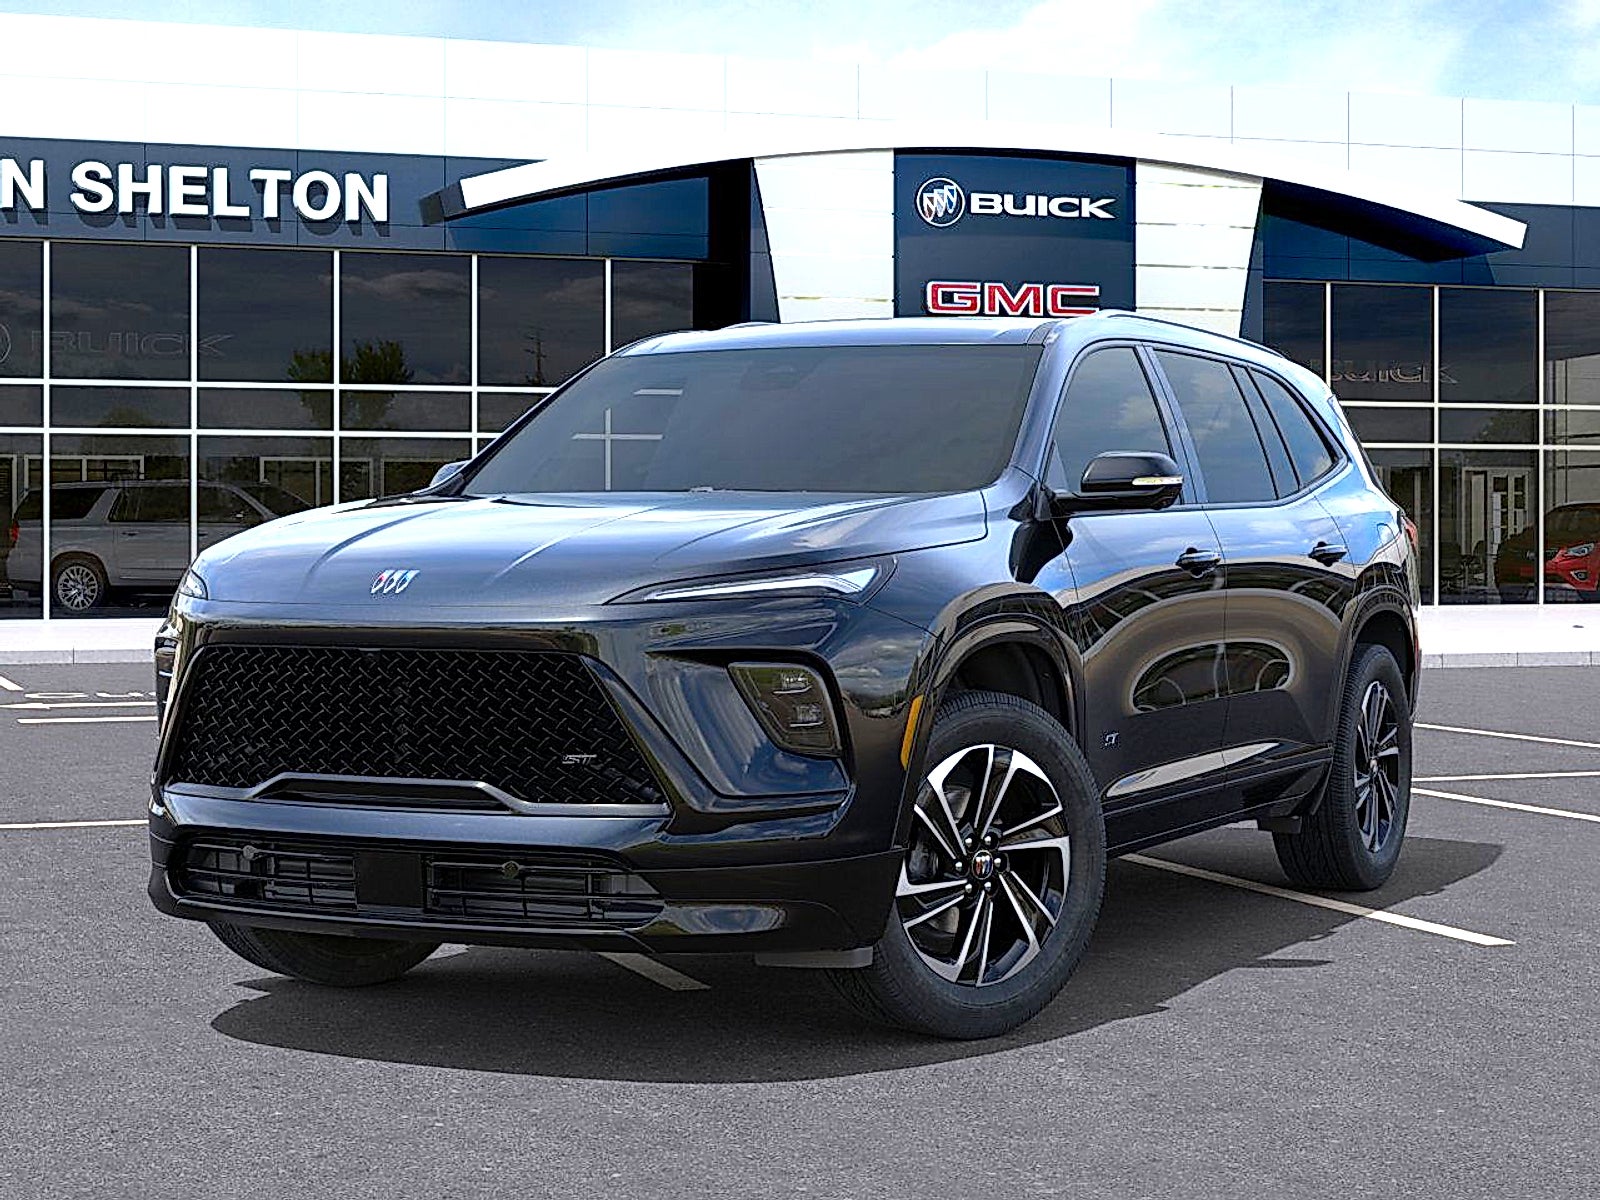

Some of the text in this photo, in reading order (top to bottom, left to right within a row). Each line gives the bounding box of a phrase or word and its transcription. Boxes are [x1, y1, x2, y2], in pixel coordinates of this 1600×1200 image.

[70, 160, 389, 223] SHELTON
[970, 192, 1117, 219] BUICK
[926, 281, 1101, 317] GMC
[31, 329, 236, 358] BUICK
